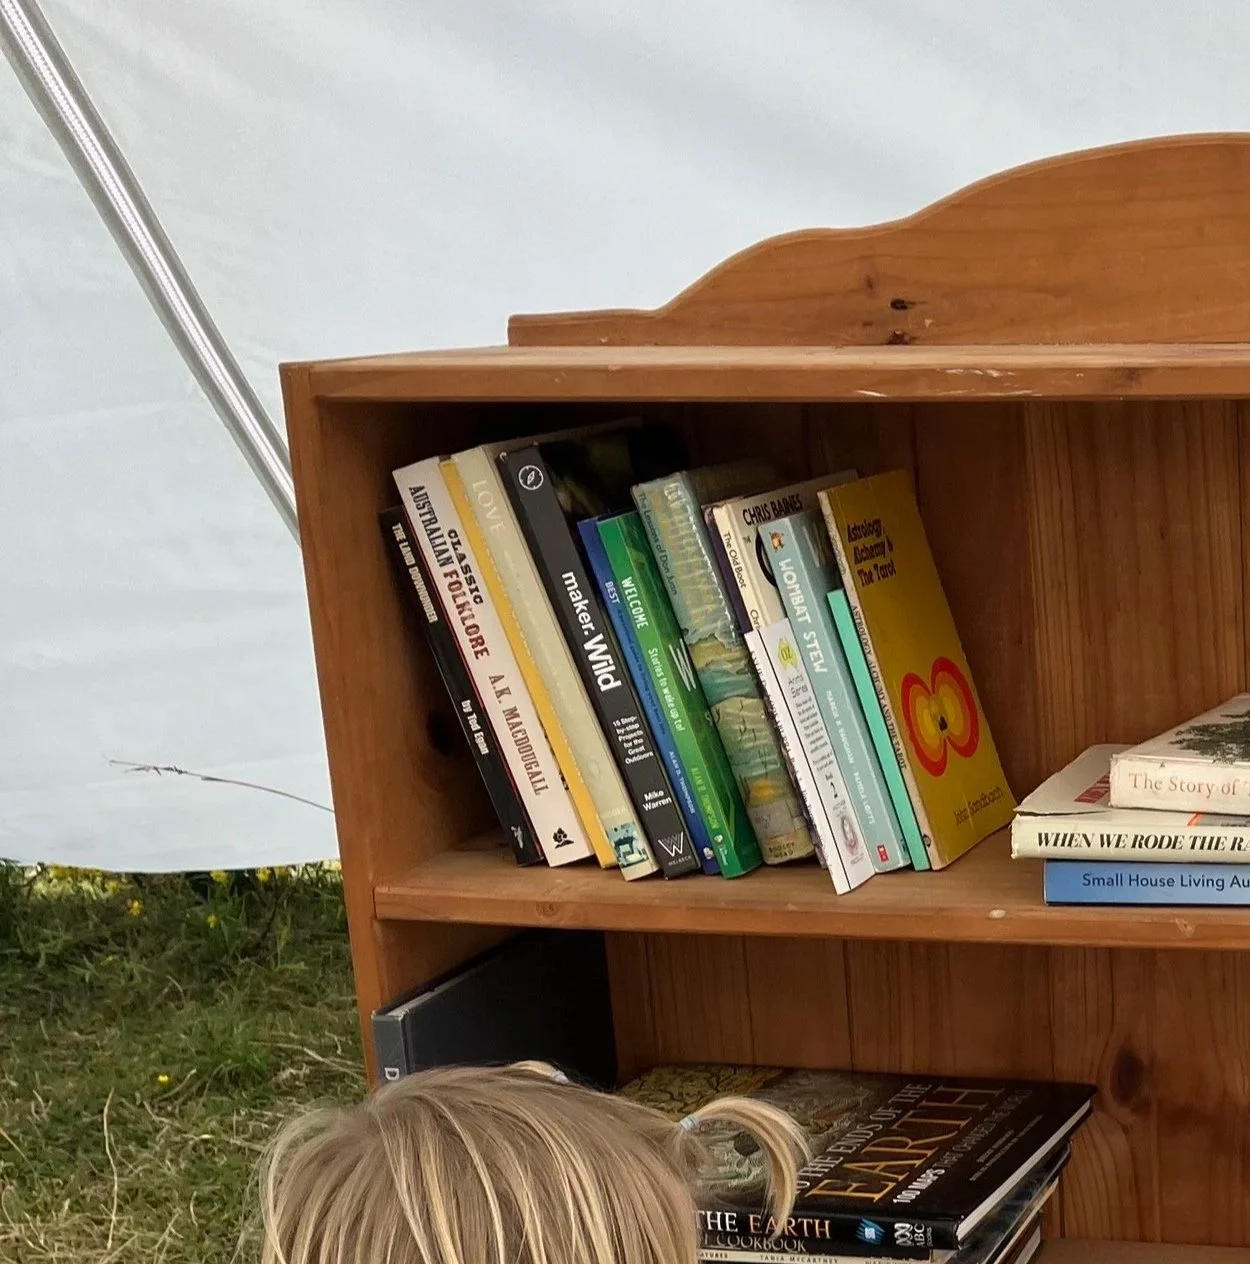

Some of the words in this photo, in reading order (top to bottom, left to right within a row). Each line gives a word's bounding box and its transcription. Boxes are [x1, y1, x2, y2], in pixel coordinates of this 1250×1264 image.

[742, 503, 771, 526] CHRIS
[771, 493, 804, 518] BAINES
[409, 485, 454, 568] AUSTRALIAN
[443, 569, 490, 660] FOLKLORE
[447, 529, 483, 604] CLASSIC
[723, 533, 732, 548] The
[728, 549, 741, 568] Old
[735, 566, 747, 588] Boot
[605, 581, 620, 604] BEST
[621, 576, 648, 629] WELCOME
[779, 558, 811, 628] WOMBAT
[803, 630, 828, 673] STEW
[467, 713, 481, 731] Ted
[489, 674, 512, 703] A.K.
[502, 706, 549, 795] MACDOUGALL
[644, 790, 664, 801] Mike
[1129, 772, 1162, 792] The
[1168, 776, 1215, 799] Story
[1221, 779, 1237, 796] of
[643, 797, 672, 811] Warren
[1036, 831, 1095, 849] WHEN
[1100, 833, 1128, 850] WE
[1131, 834, 1184, 851] RODE
[1189, 835, 1230, 851] THE
[1082, 873, 1124, 888] Small
[1128, 874, 1176, 888] House
[1180, 874, 1225, 893] Living
[804, 1085, 1005, 1203] EARTH
[696, 1209, 738, 1233] THE
[749, 1214, 831, 1240] EARTH
[913, 1223, 925, 1248] ABC
[760, 1254, 784, 1262] TANIA
